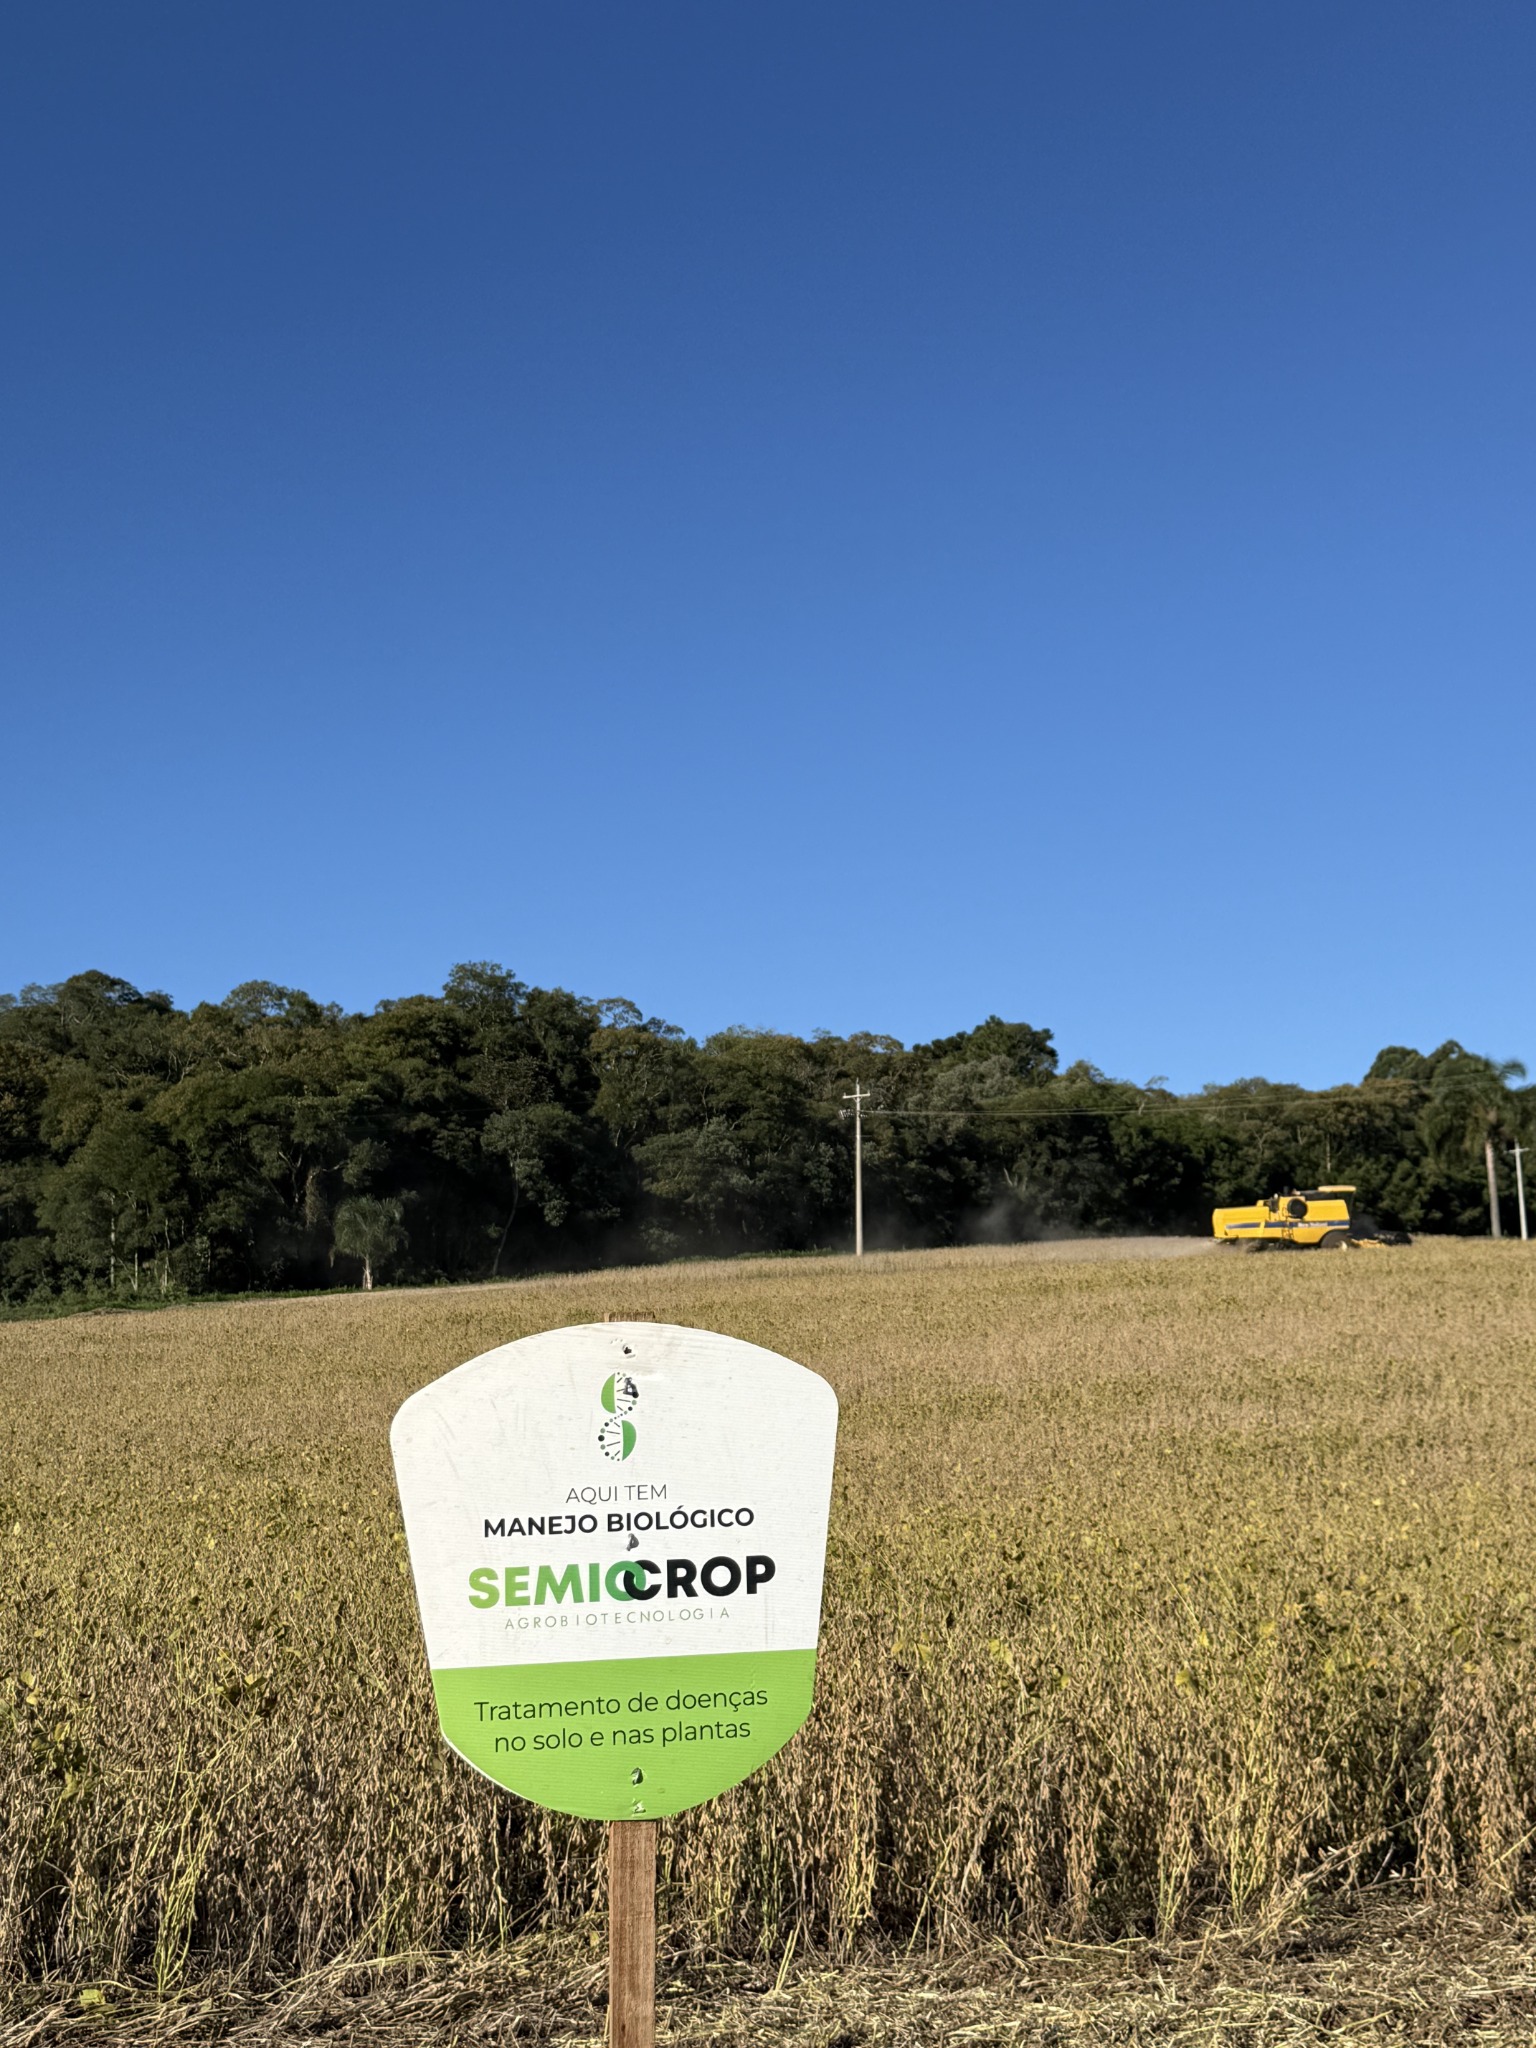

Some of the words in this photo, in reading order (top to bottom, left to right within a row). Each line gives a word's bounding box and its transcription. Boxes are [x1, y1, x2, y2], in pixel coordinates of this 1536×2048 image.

[565, 1486, 618, 1505] AQUI
[624, 1484, 667, 1500] TEM
[484, 1514, 598, 1538] MANEJO
[607, 1505, 755, 1533] BIOLÓGICO
[504, 1607, 730, 1630] AGROBIOTECNOLOGIA
[474, 1696, 621, 1722] Tratamento
[627, 1691, 659, 1713] de
[665, 1689, 768, 1713] doenças
[494, 1734, 526, 1753] no
[533, 1728, 583, 1750] solo
[590, 1730, 604, 1747] e
[612, 1727, 655, 1746] nas
[662, 1720, 751, 1748] plantas
